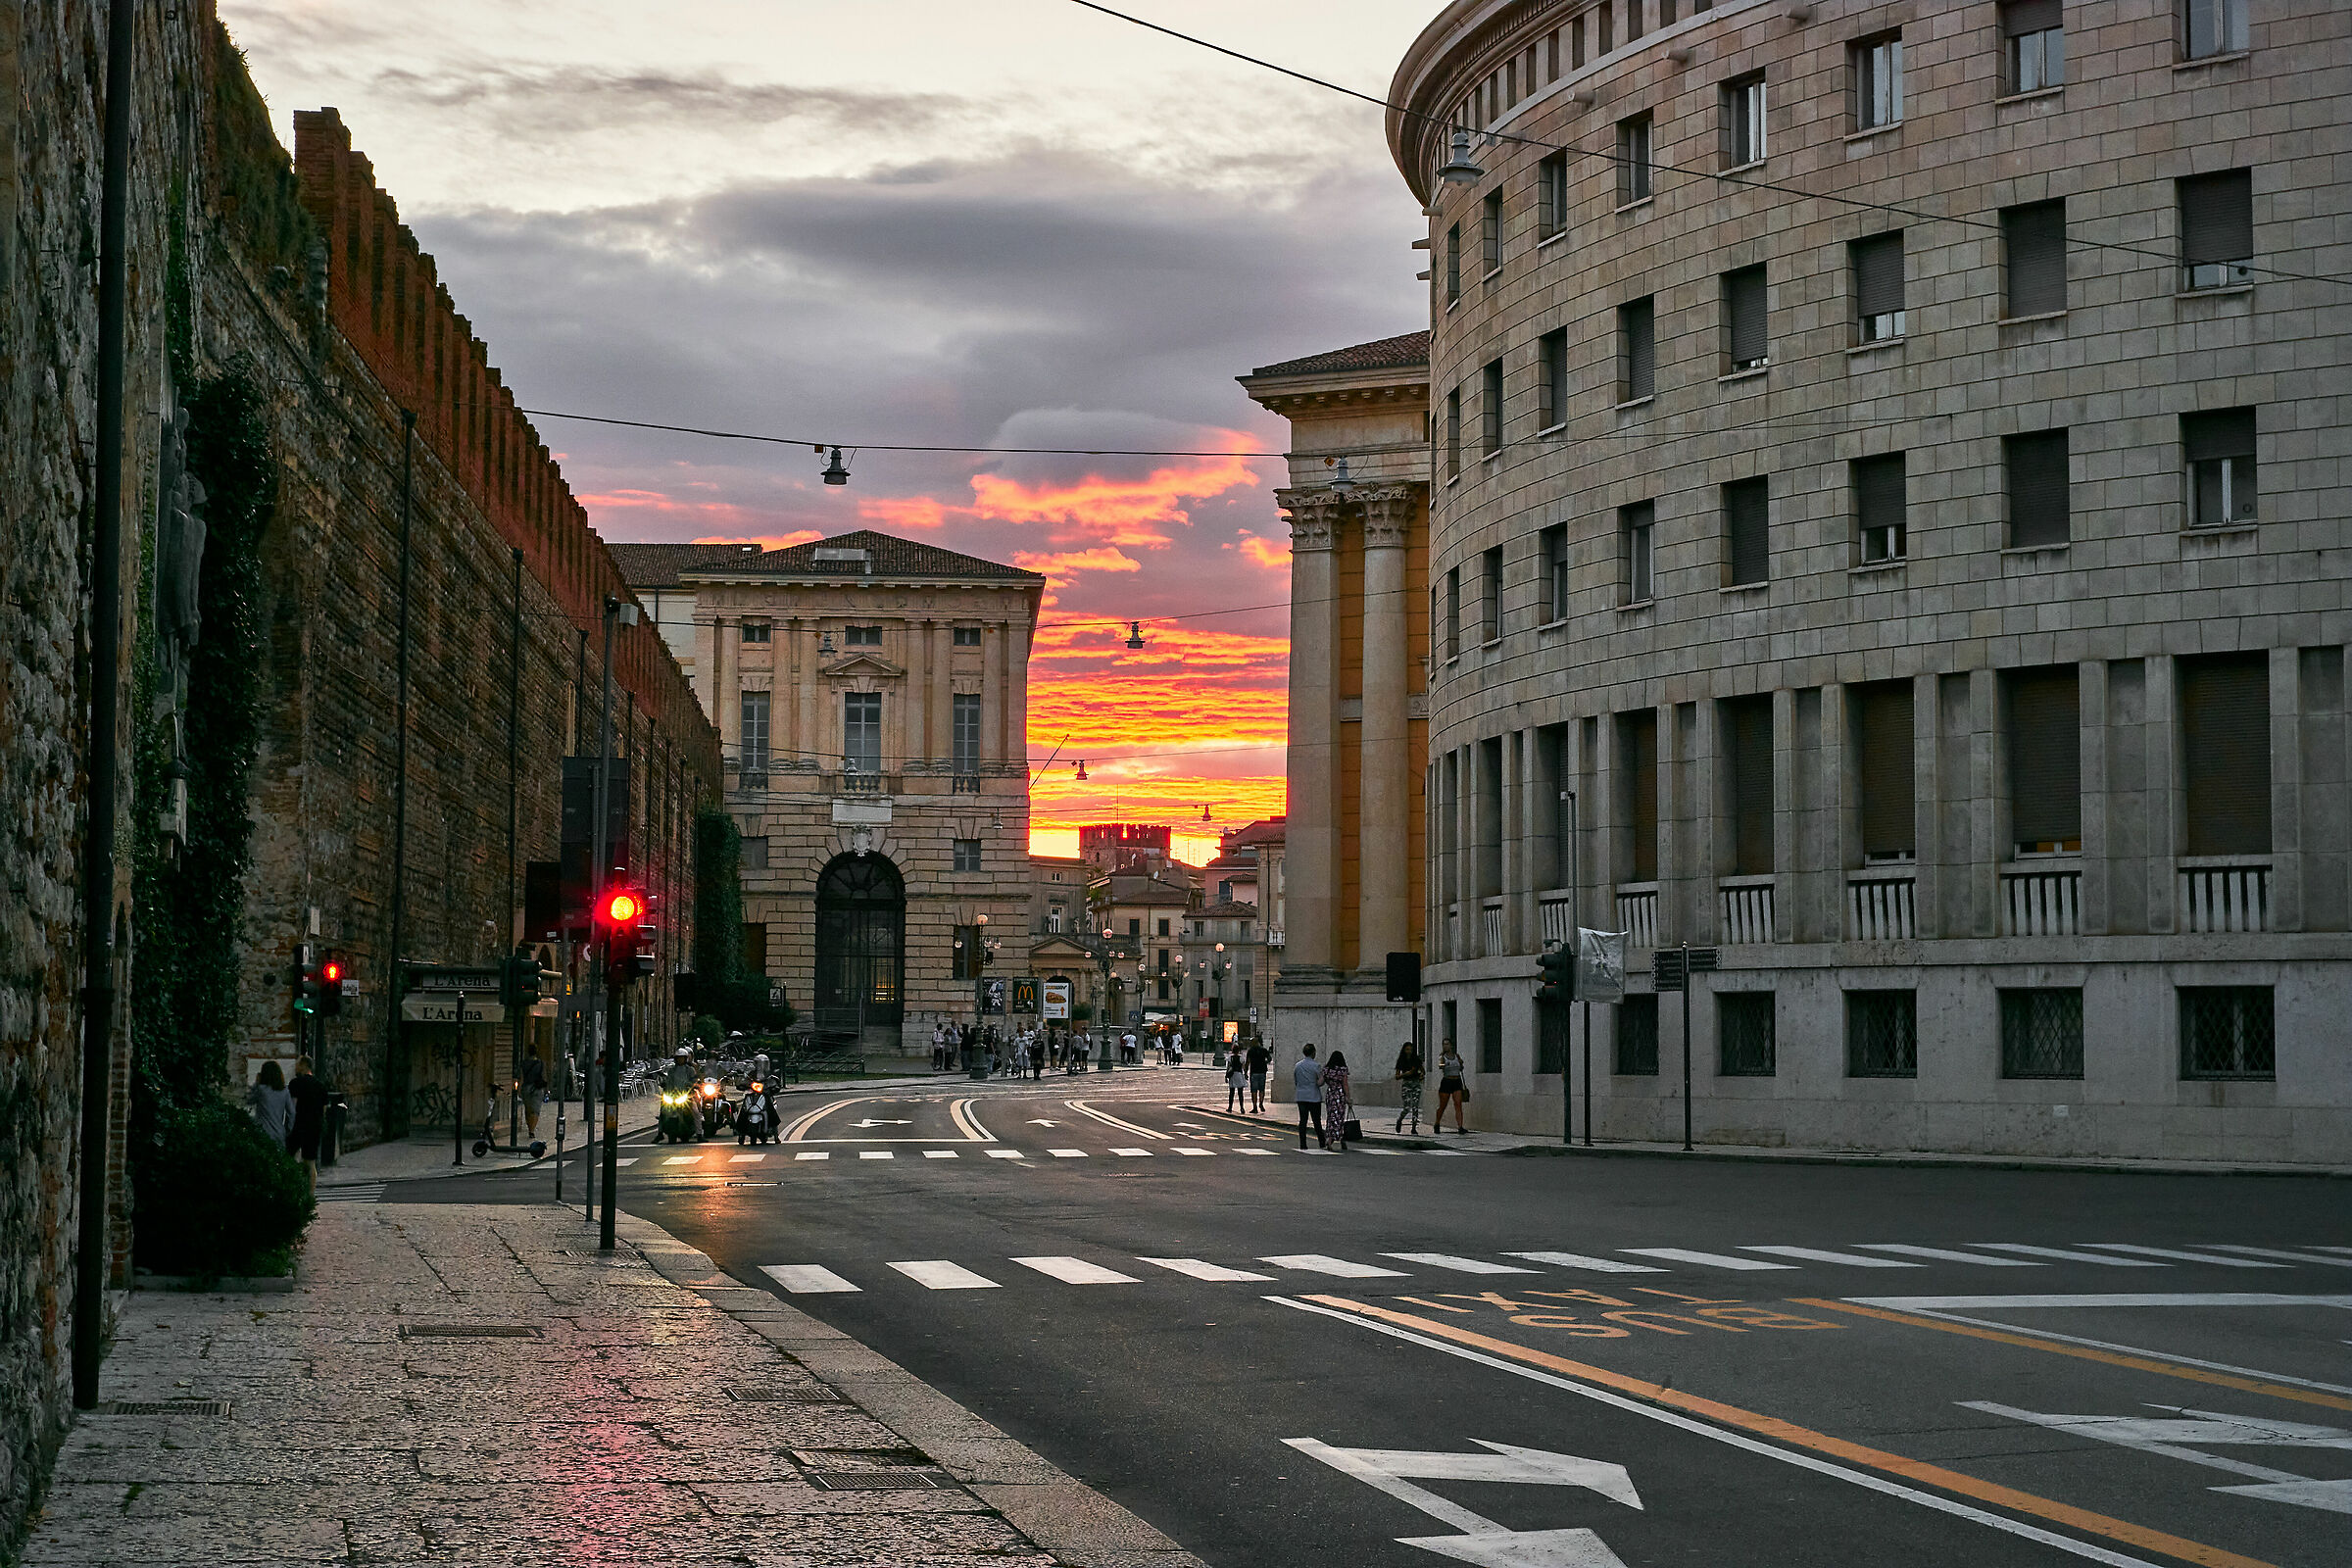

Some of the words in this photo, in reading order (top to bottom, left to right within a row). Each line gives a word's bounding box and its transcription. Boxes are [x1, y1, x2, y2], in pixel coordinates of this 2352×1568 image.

[434, 974, 491, 986] L'Arena
[1392, 1288, 1743, 1313] TAXI
[1508, 1307, 1849, 1339] BUS
